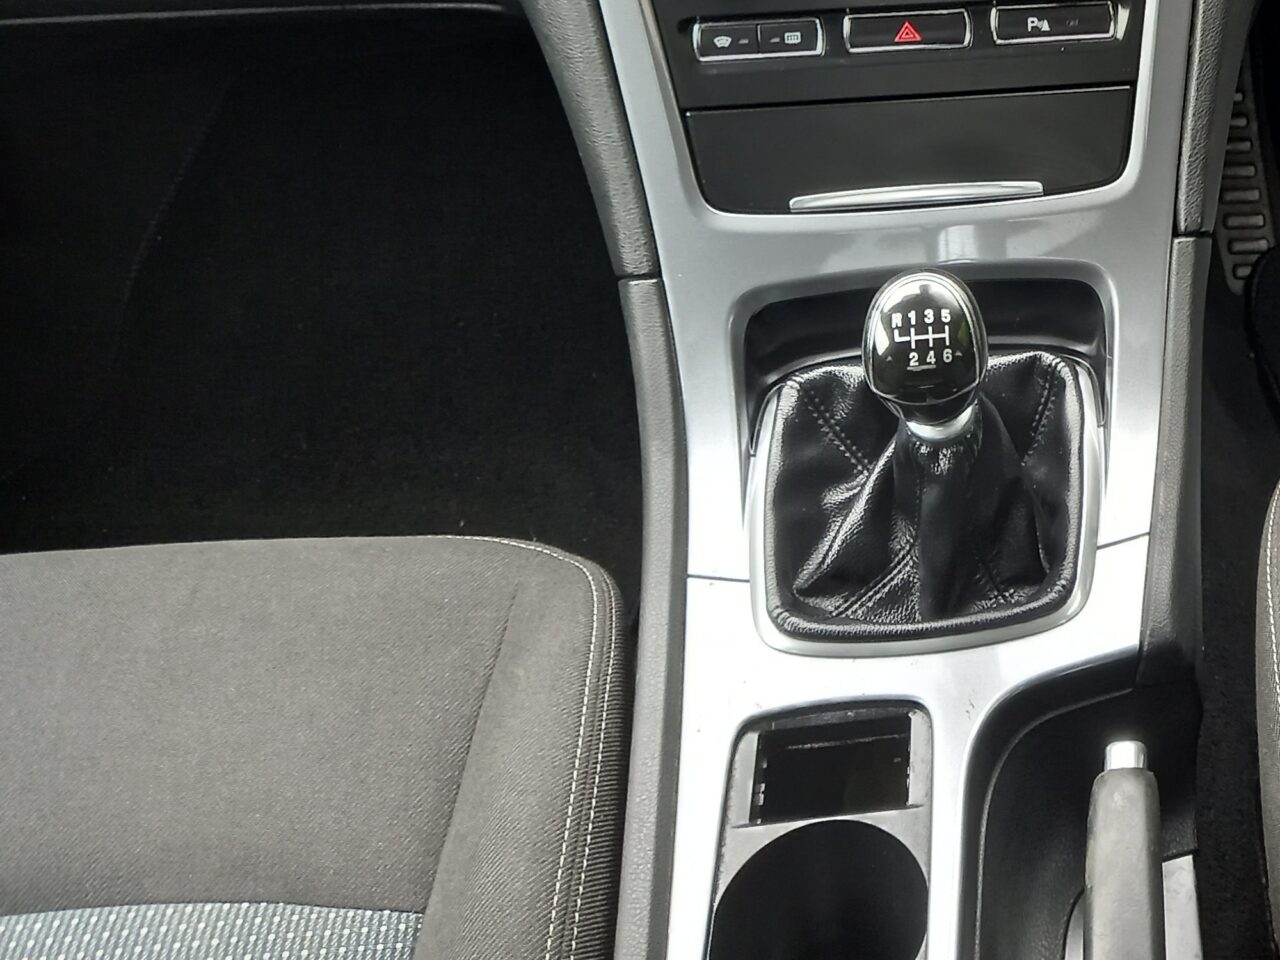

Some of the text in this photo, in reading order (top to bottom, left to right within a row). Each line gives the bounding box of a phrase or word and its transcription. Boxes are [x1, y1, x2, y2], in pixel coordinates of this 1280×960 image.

[891, 308, 951, 328] R 1 3 5
[908, 348, 953, 366] 2 4 6
